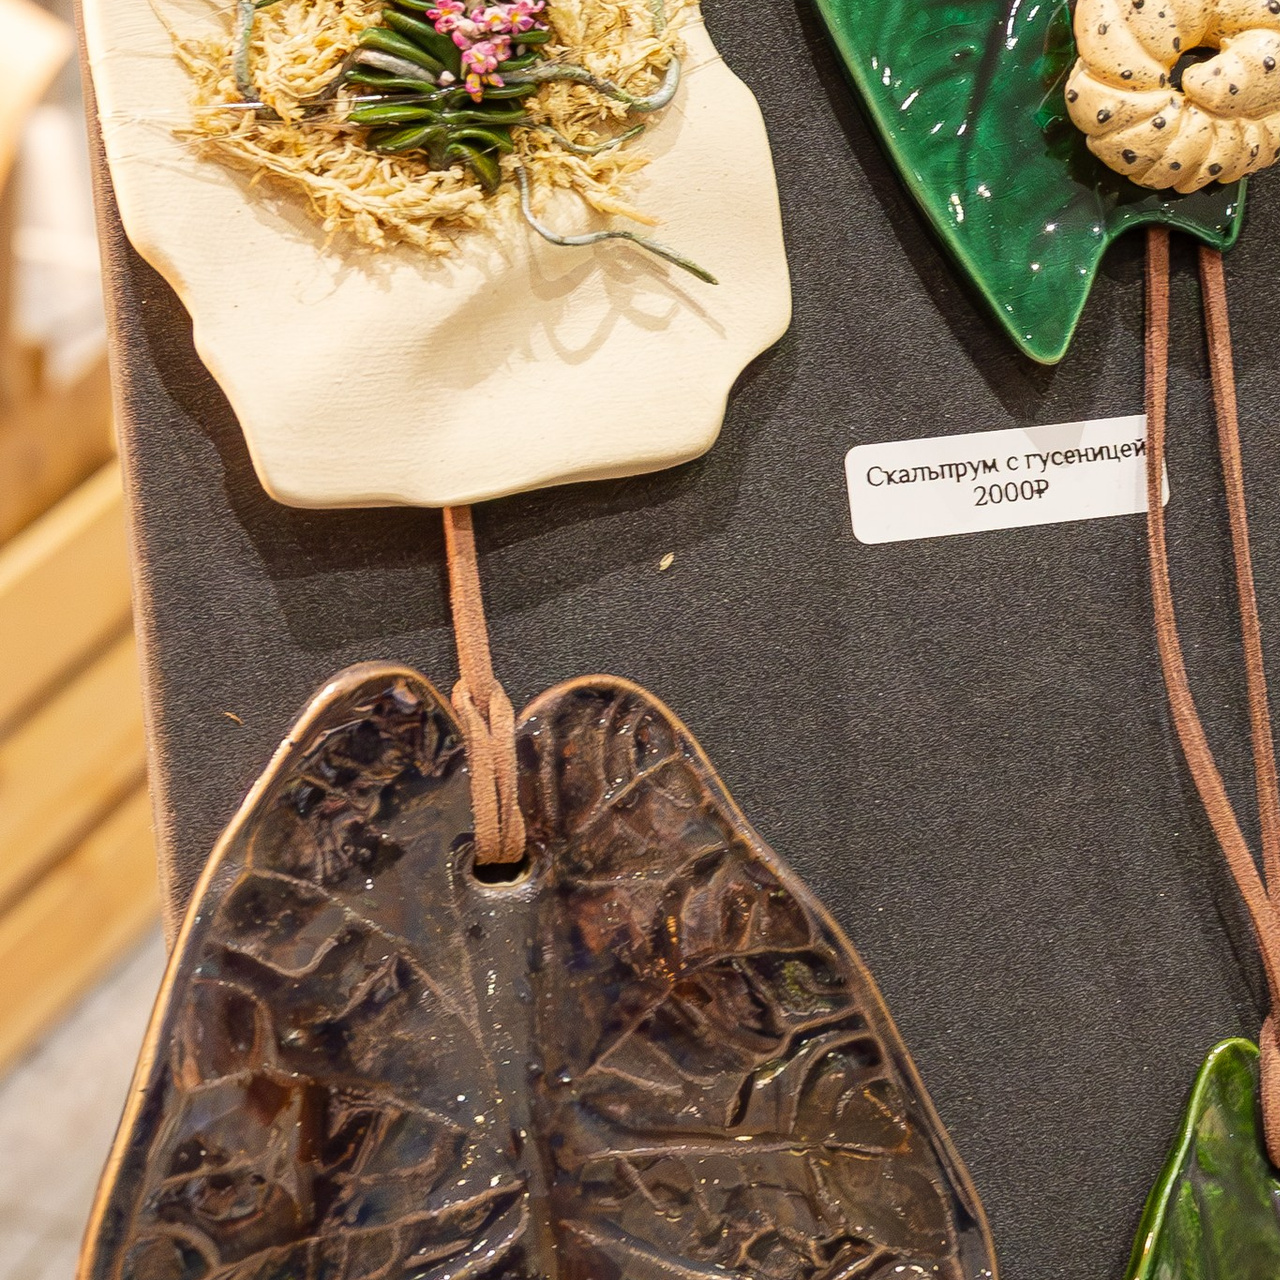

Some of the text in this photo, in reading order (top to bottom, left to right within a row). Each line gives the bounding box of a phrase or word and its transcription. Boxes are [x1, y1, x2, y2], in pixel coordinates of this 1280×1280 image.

[866, 437, 1147, 487] Скальпрум с гусеницей
[973, 478, 1050, 507] 2000₽
